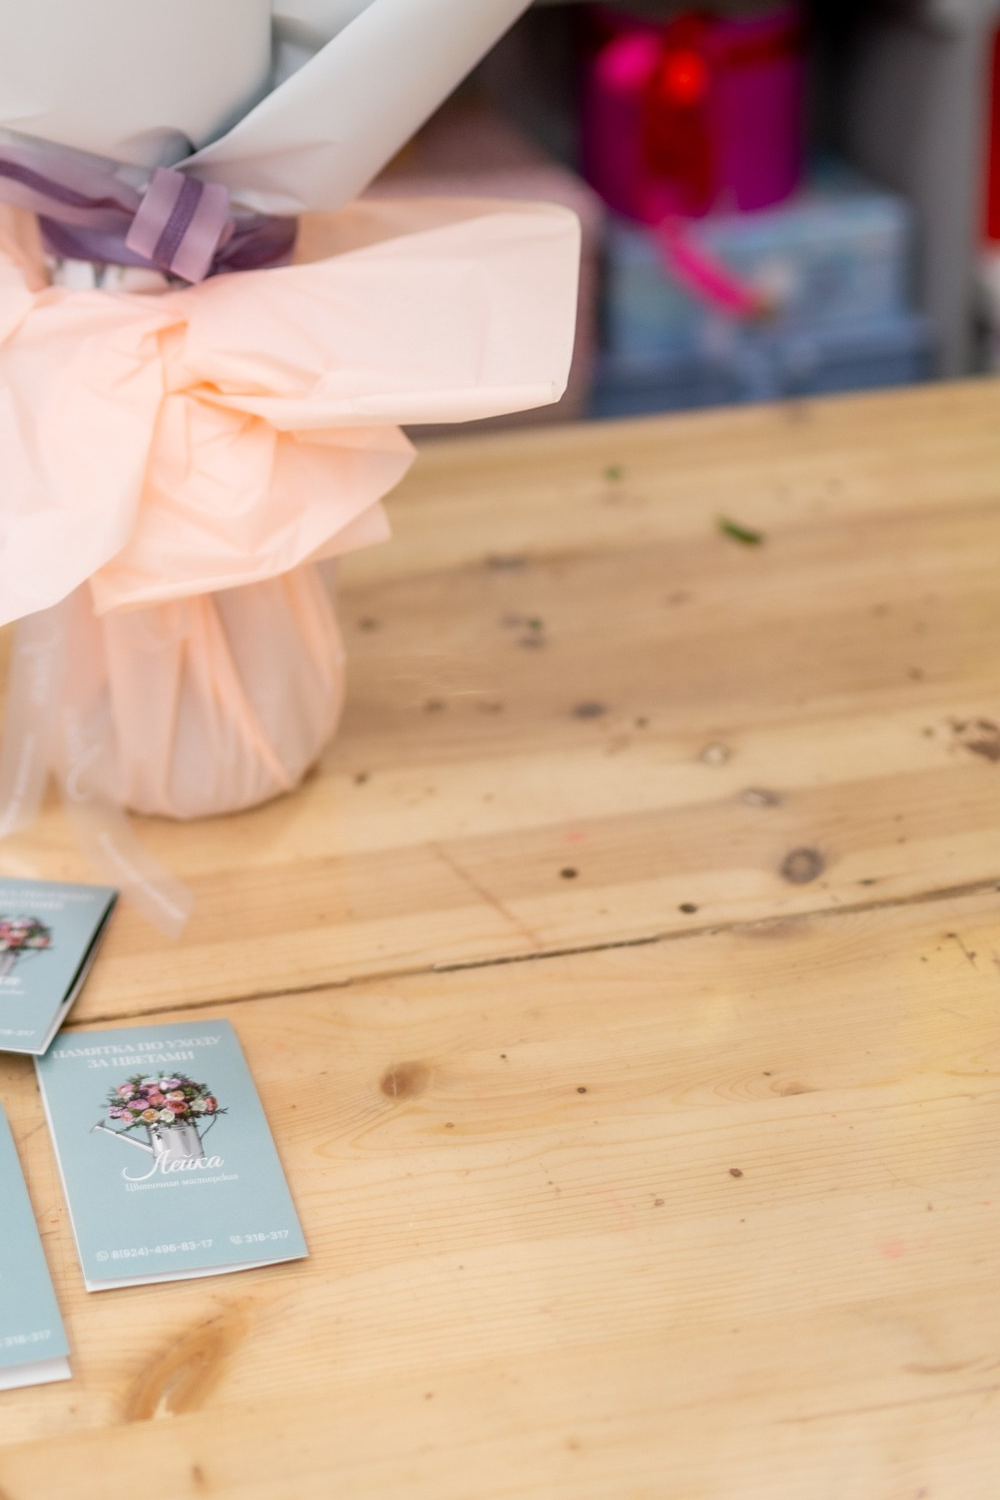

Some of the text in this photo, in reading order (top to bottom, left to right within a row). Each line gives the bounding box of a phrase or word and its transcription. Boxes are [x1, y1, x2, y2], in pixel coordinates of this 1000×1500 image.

[54, 1035, 222, 1059] ПАМЯТКА ПО УХОДУ
[88, 1052, 196, 1069] ЗА ЦВЕТАМИ
[122, 1150, 225, 1182] Лейка
[111, 1230, 289, 1260] 8(924)-496-83-17 318-317
